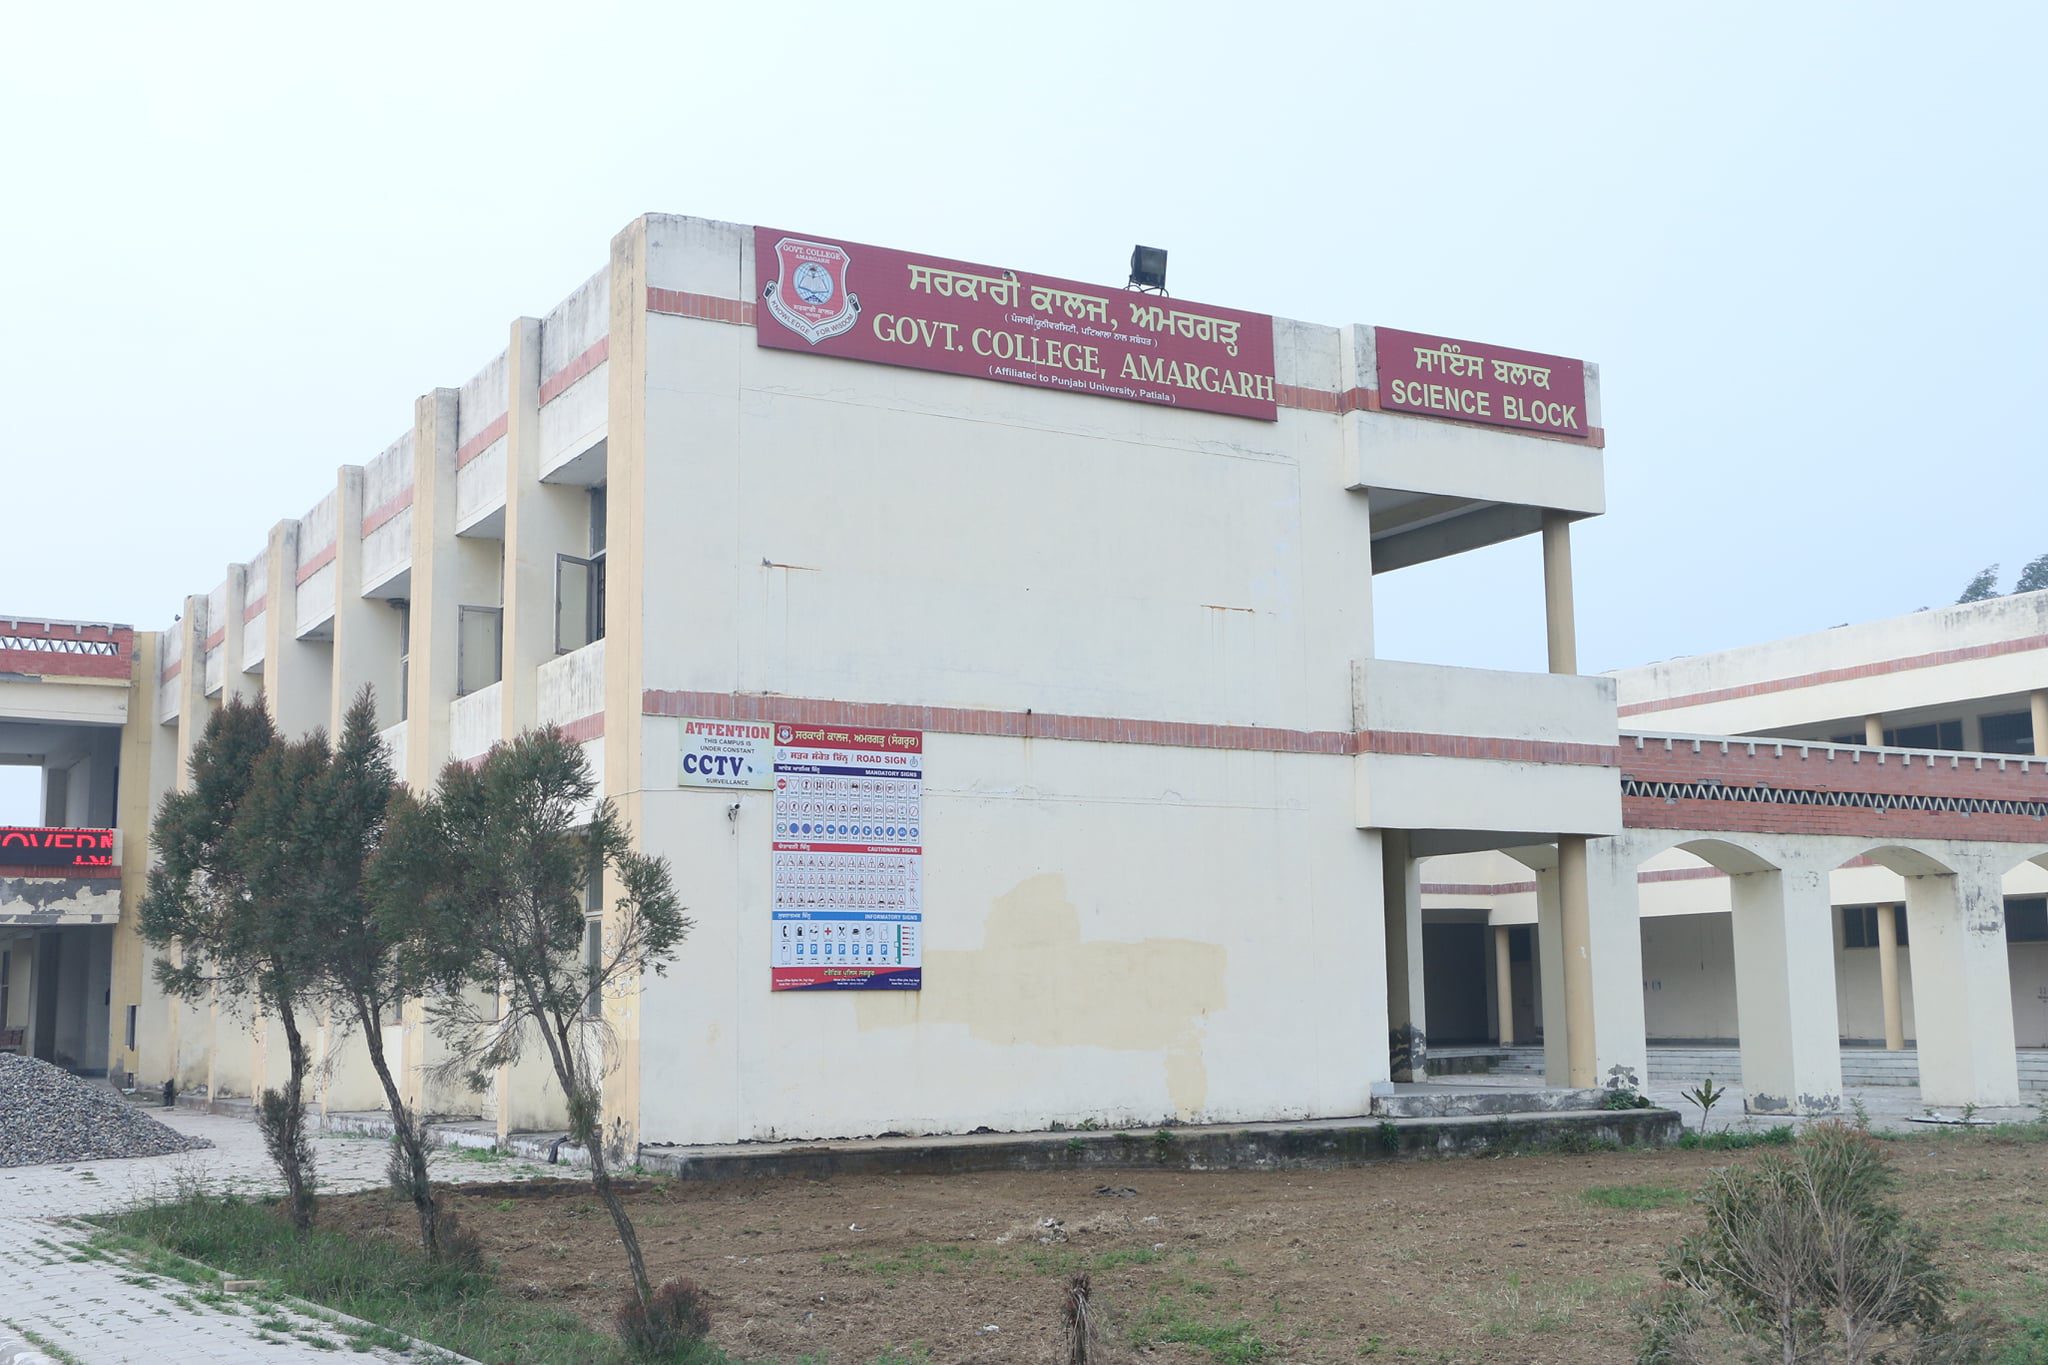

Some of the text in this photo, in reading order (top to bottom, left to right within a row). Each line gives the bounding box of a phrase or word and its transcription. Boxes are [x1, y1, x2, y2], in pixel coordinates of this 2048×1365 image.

[907, 264, 1241, 357] ਸਰਕਾਰੀ ਕਾਲਜ, ਅਮਰਗੜ੍ਹ
[815, 326, 830, 337] FOR
[831, 313, 853, 332] WISDOM
[873, 313, 1276, 402] GOVT. COLLEGE, AMARGARH
[1413, 343, 1551, 390] ਸਾਇੰਸ ਬਲਾਕ
[1039, 373, 1049, 383] to
[1051, 376, 1087, 389] Punjabi
[1089, 382, 1138, 398] University,
[1140, 389, 1170, 401] Patiala
[1391, 379, 1578, 429] SCIENCE BLOCK
[685, 721, 770, 740] ATTENTION
[704, 737, 718, 745] THIS
[719, 738, 745, 747] CAMPUS
[722, 746, 755, 754] CONSTANT
[856, 754, 882, 764] ROAD
[884, 755, 907, 765] SIGN
[683, 753, 744, 777] CCTV
[865, 769, 900, 777] MANDATORY
[706, 777, 749, 786] SURVEILLANCE
